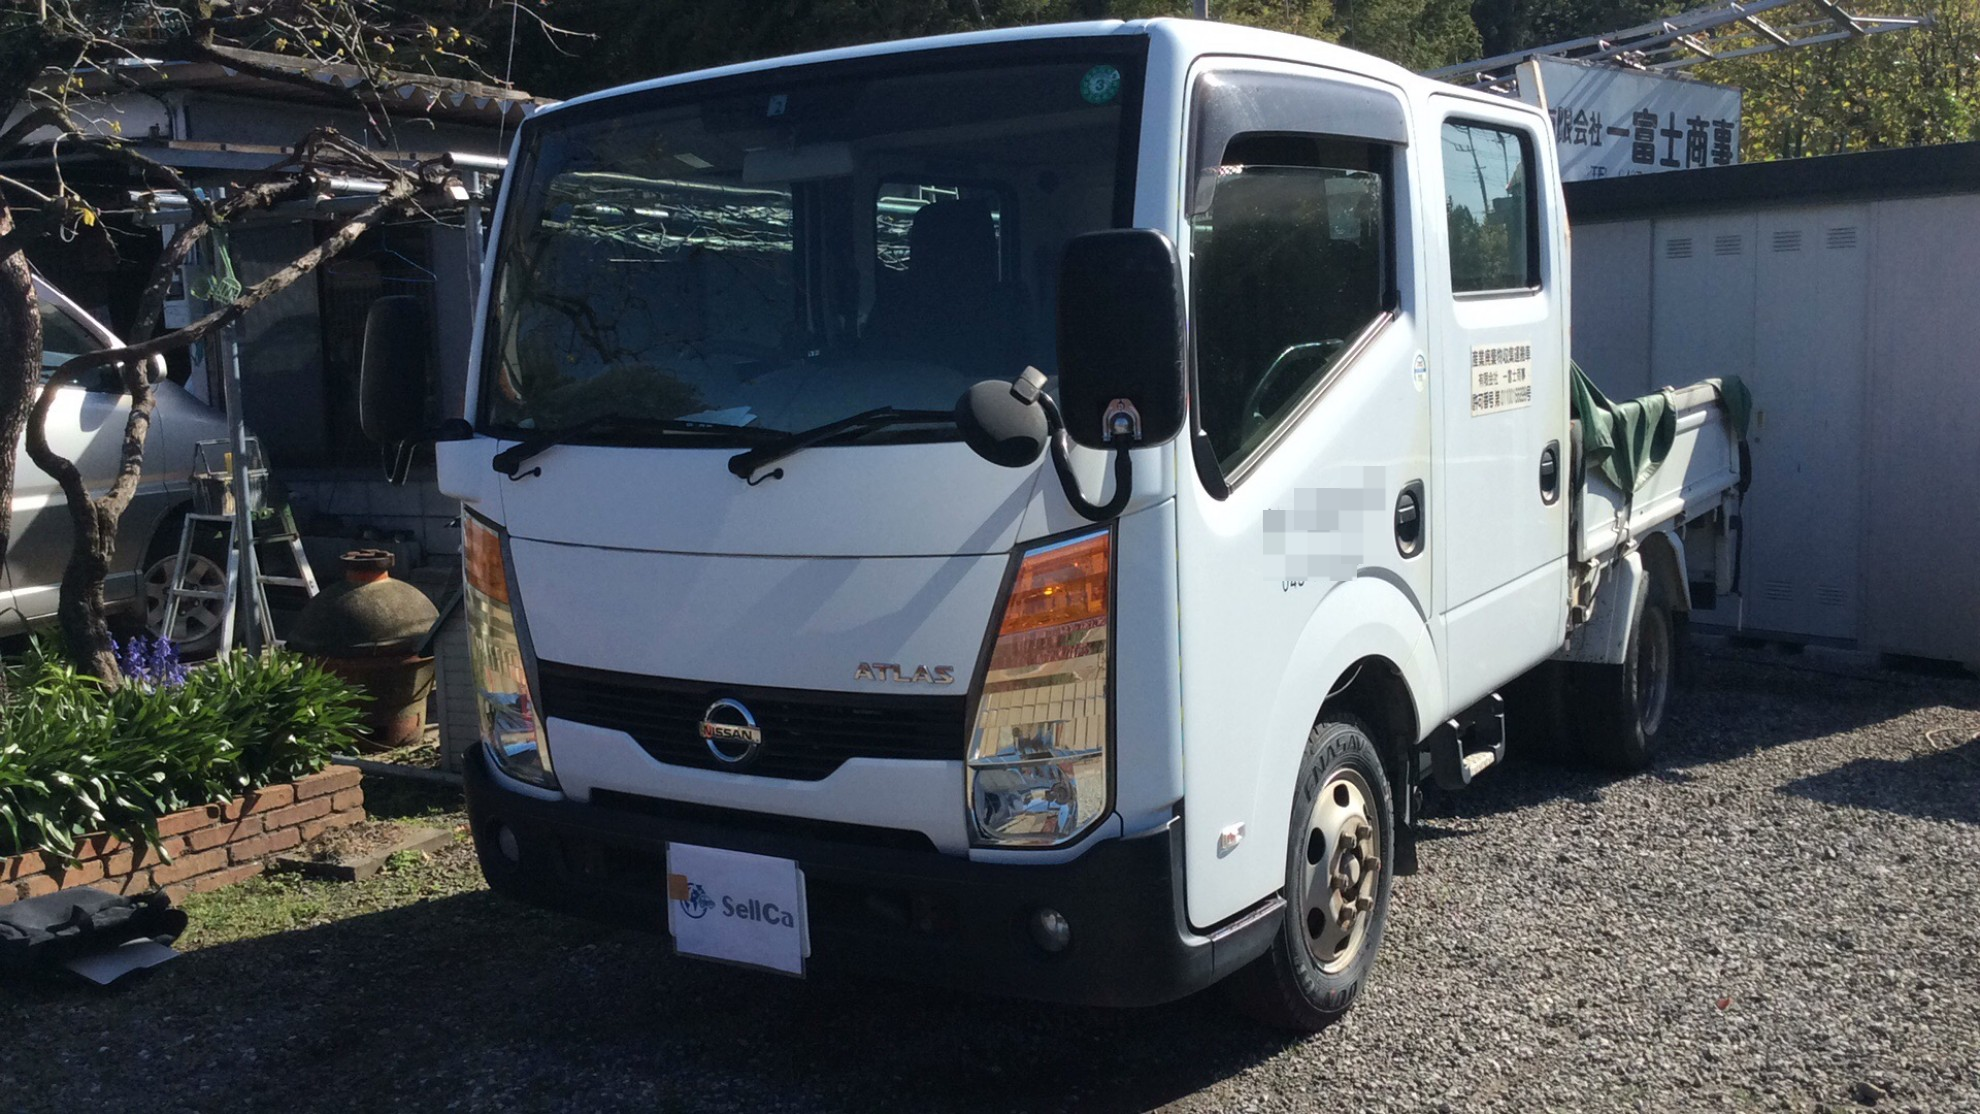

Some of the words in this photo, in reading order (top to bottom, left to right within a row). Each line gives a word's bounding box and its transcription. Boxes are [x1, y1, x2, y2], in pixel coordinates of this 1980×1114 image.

[854, 661, 955, 685] ATLAS
[703, 723, 752, 741] NISSAN
[722, 895, 794, 929] SellCa
